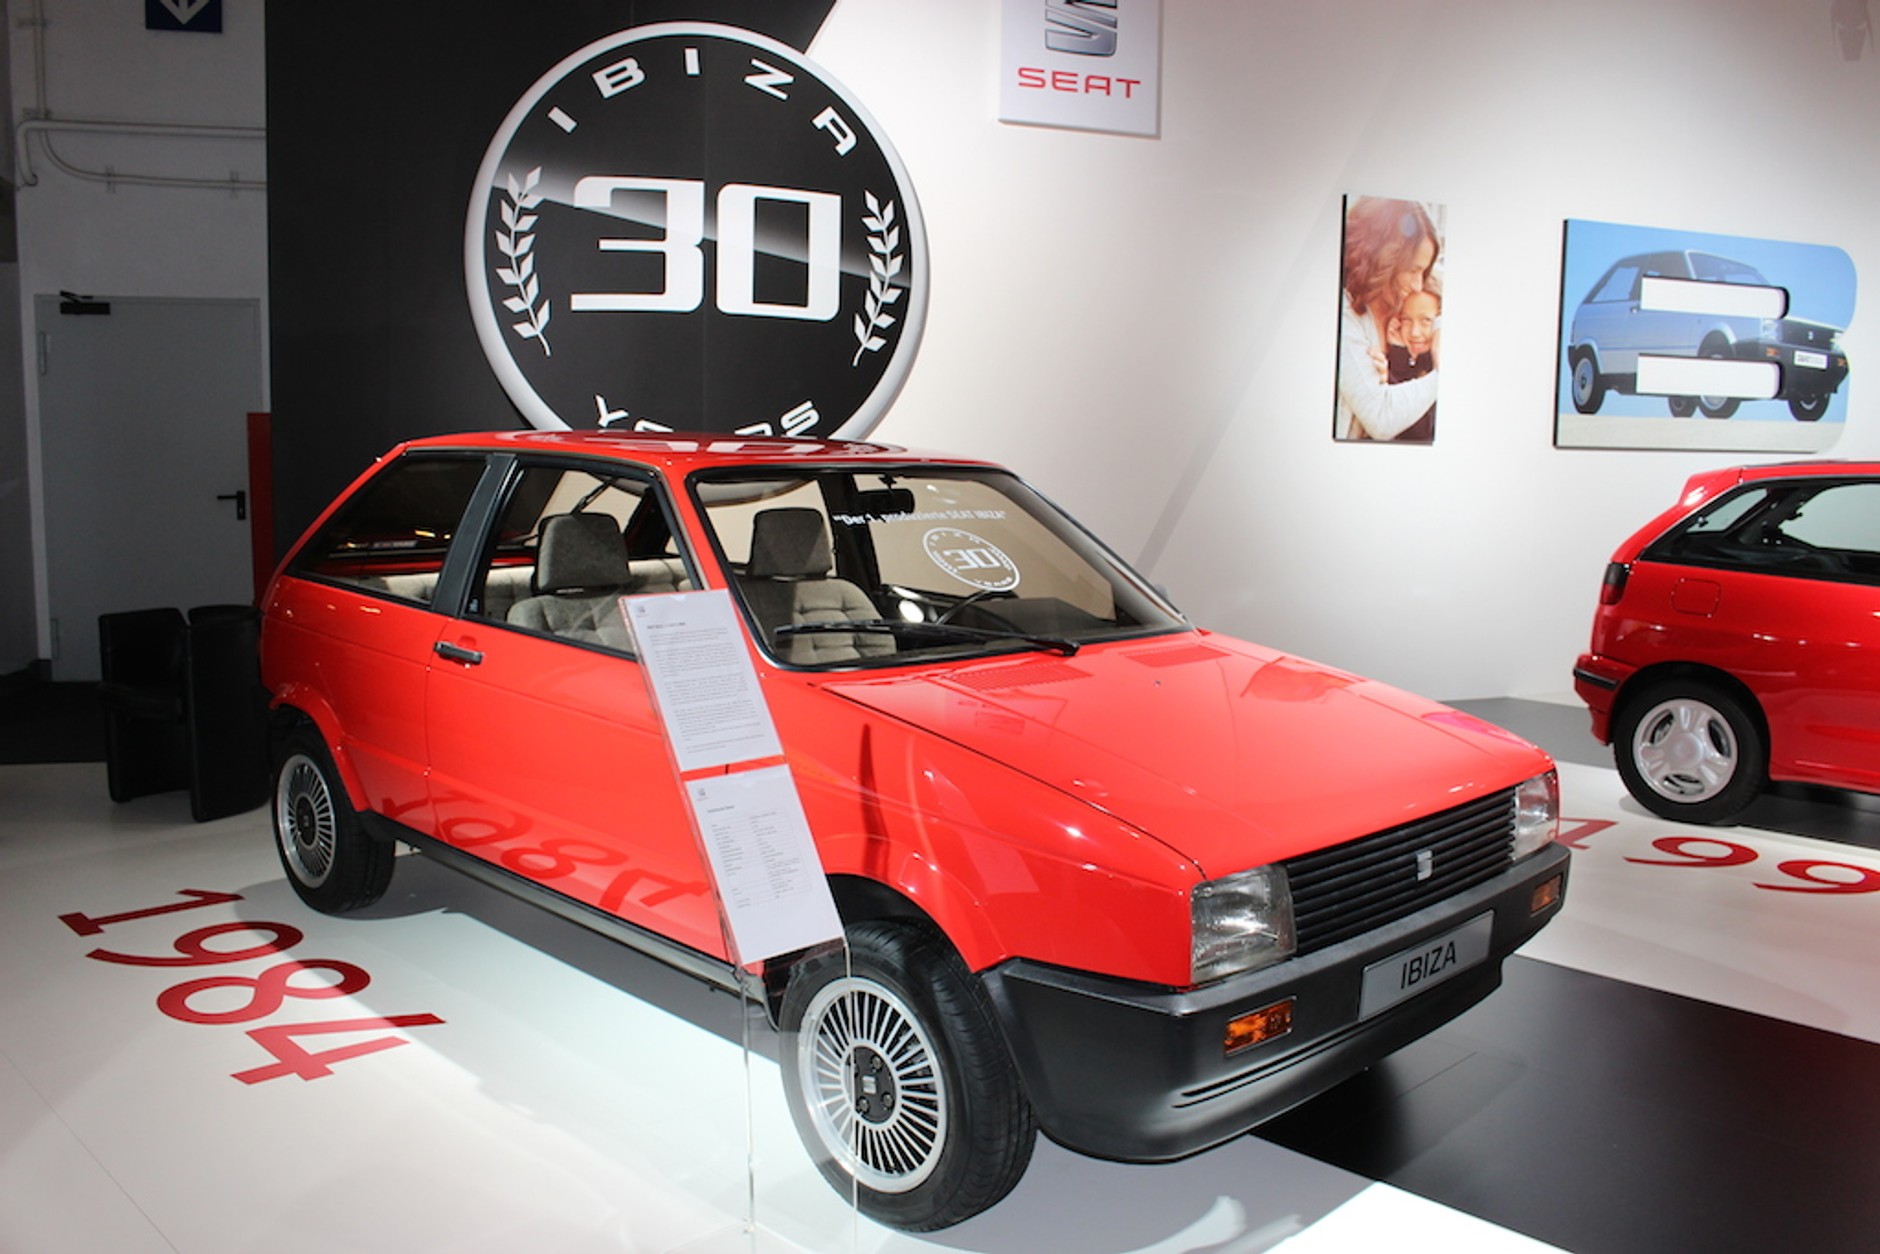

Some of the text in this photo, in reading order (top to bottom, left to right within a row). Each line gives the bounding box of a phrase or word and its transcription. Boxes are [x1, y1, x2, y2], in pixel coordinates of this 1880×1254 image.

[548, 48, 857, 155] IBIZA
[1018, 67, 1141, 98] SEAT
[571, 176, 841, 321] 30
[943, 548, 1001, 570] 30
[58, 888, 447, 1085] 1984
[1401, 941, 1456, 990] IBIZA
